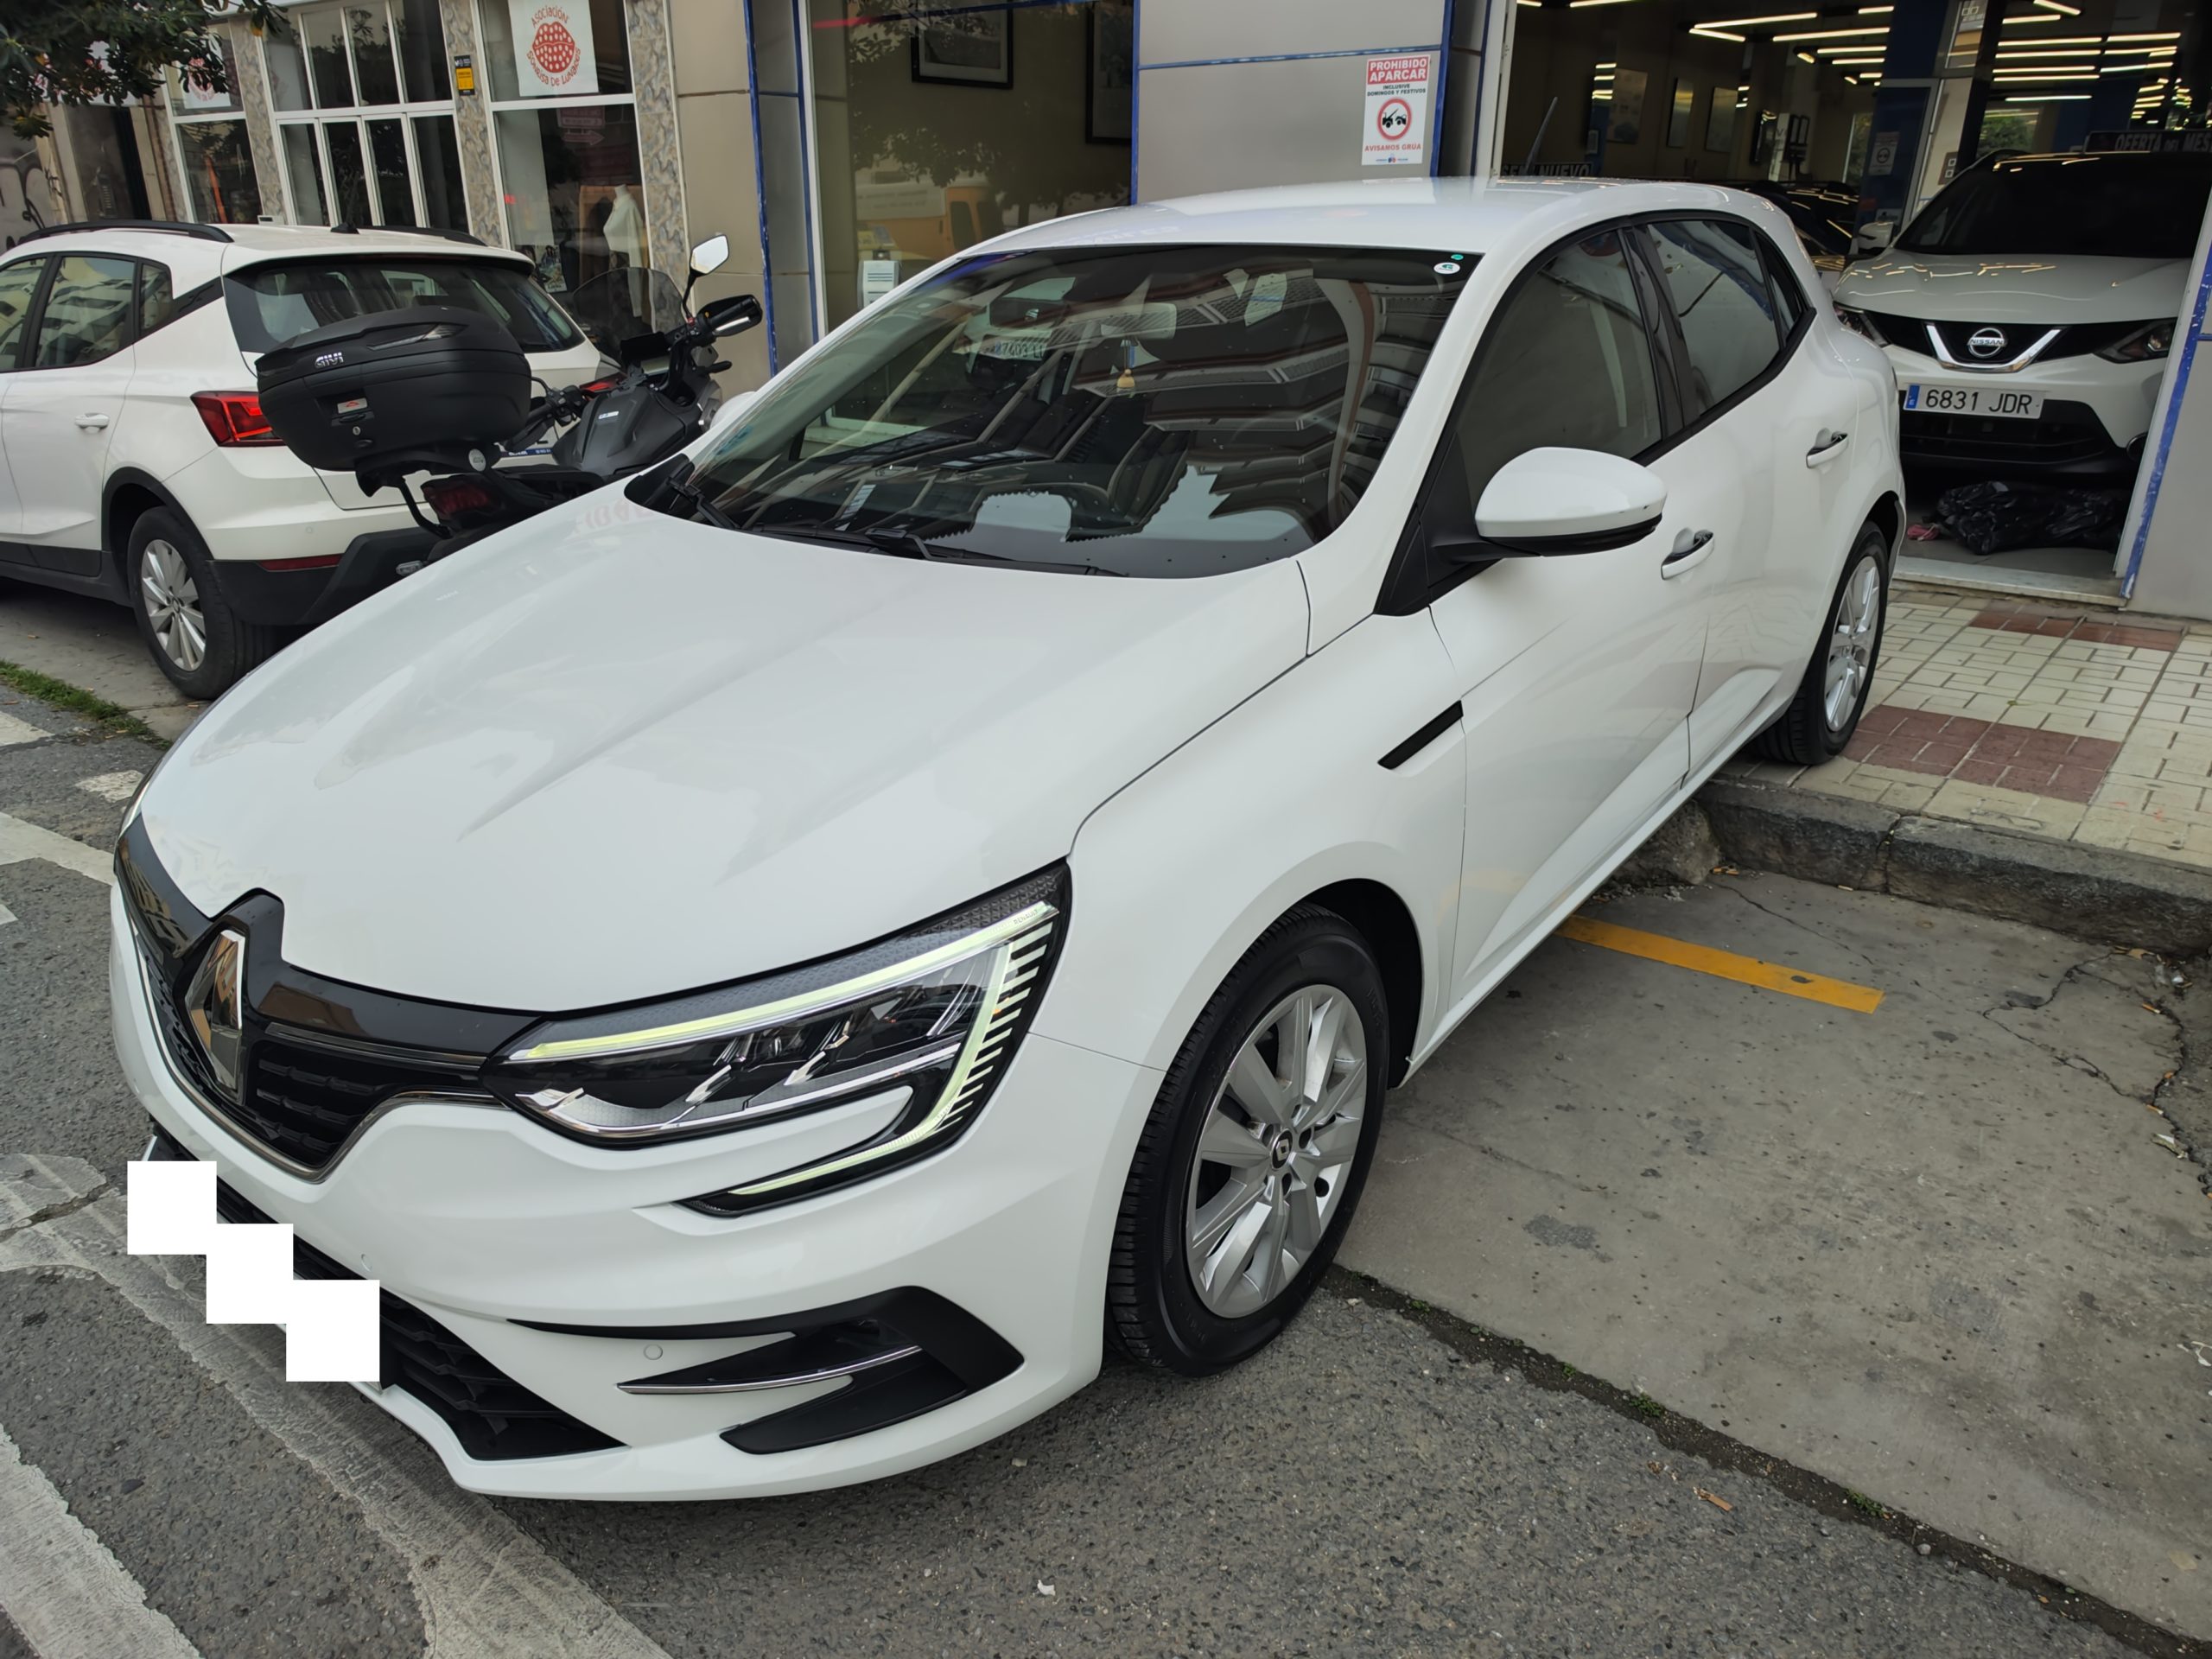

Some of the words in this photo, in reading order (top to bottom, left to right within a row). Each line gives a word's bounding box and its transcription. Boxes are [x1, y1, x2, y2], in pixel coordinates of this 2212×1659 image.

[1370, 59, 1427, 71] PROHIBIDO
[1370, 68, 1426, 82] APARCAR
[1364, 143, 1400, 152] AVISAMOS
[2114, 132, 2162, 152] OFERTA
[315, 352, 344, 368] GIVI
[1926, 389, 1979, 411] 6831
[1988, 393, 2032, 414] JDR
